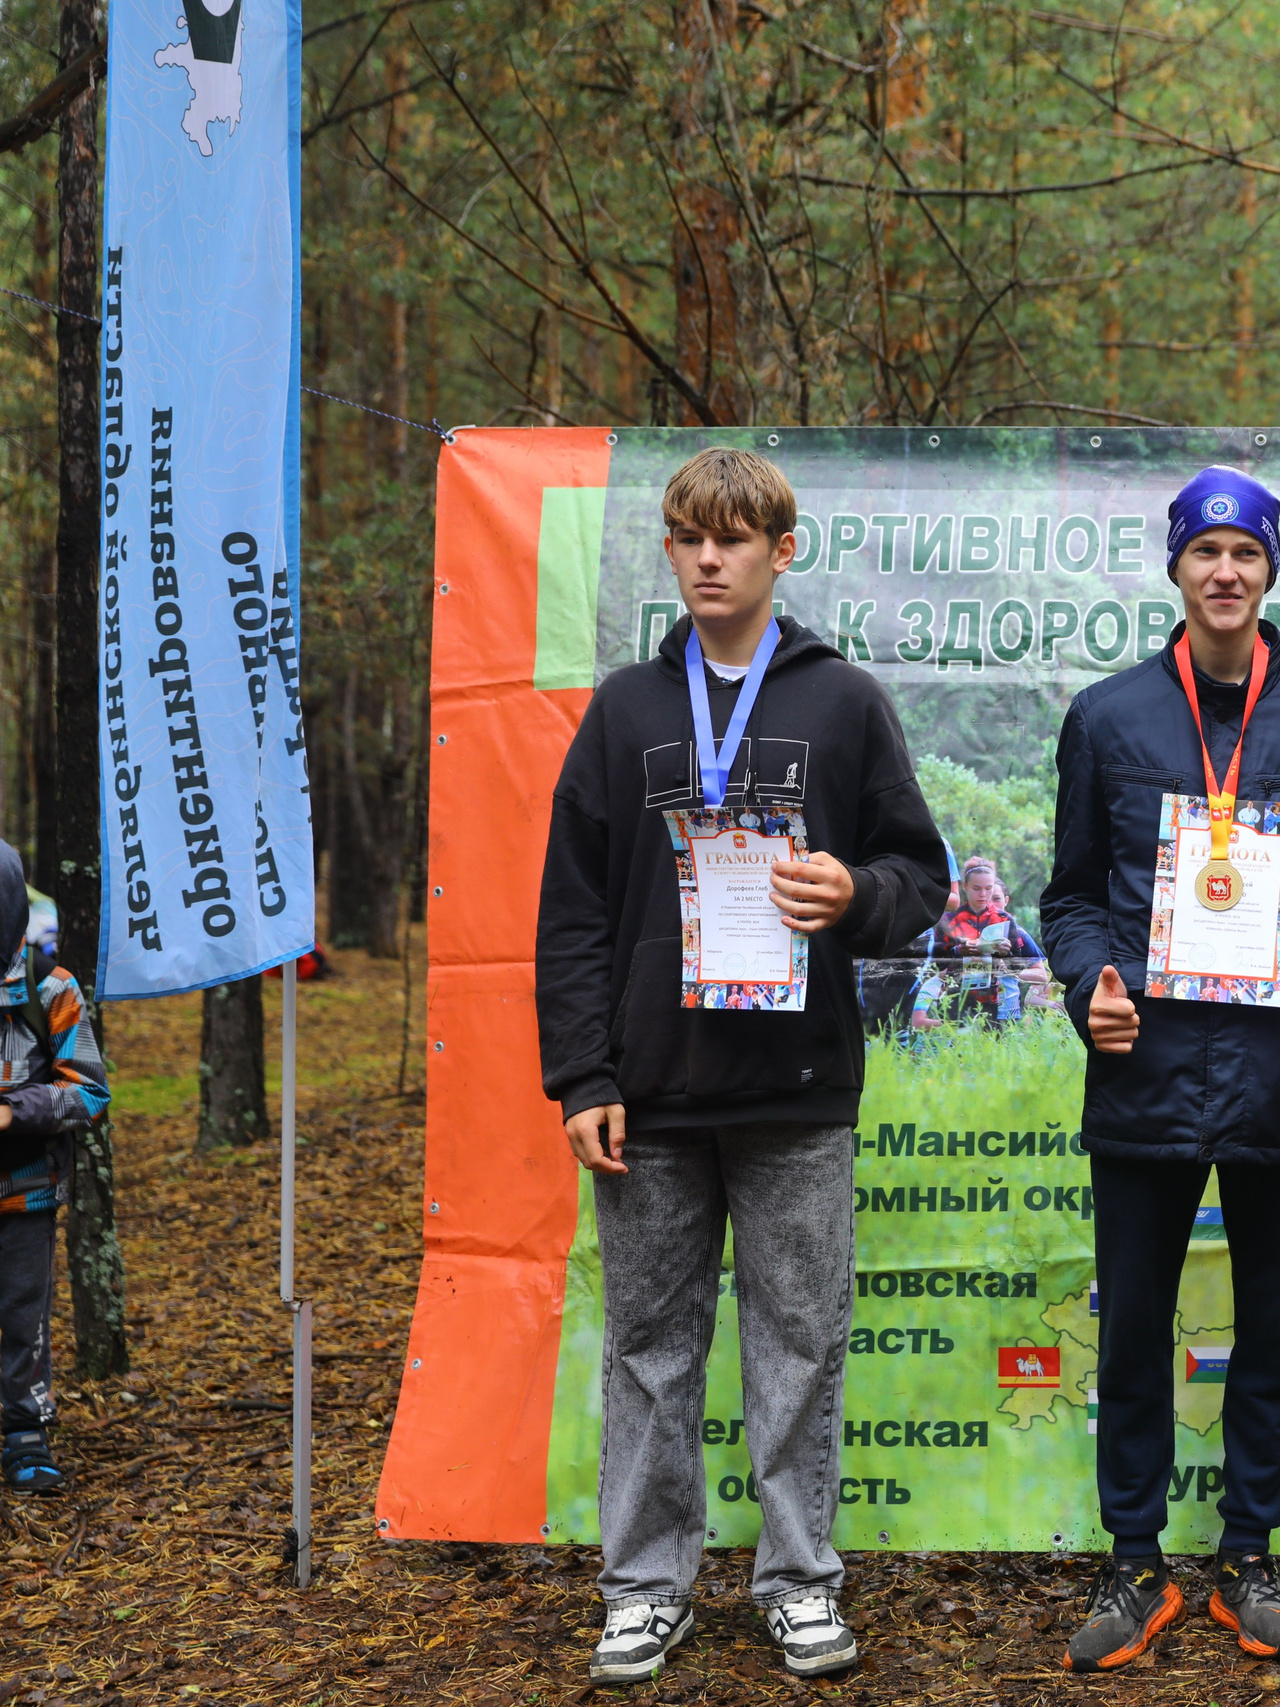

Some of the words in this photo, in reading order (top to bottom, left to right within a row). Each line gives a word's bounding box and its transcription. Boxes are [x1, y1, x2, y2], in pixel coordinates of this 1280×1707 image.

[788, 514, 1145, 576] ОРТИВНОЕ
[837, 600, 876, 662] К
[705, 852, 779, 864] ГРАМОТА
[849, 1327, 955, 1354] асть
